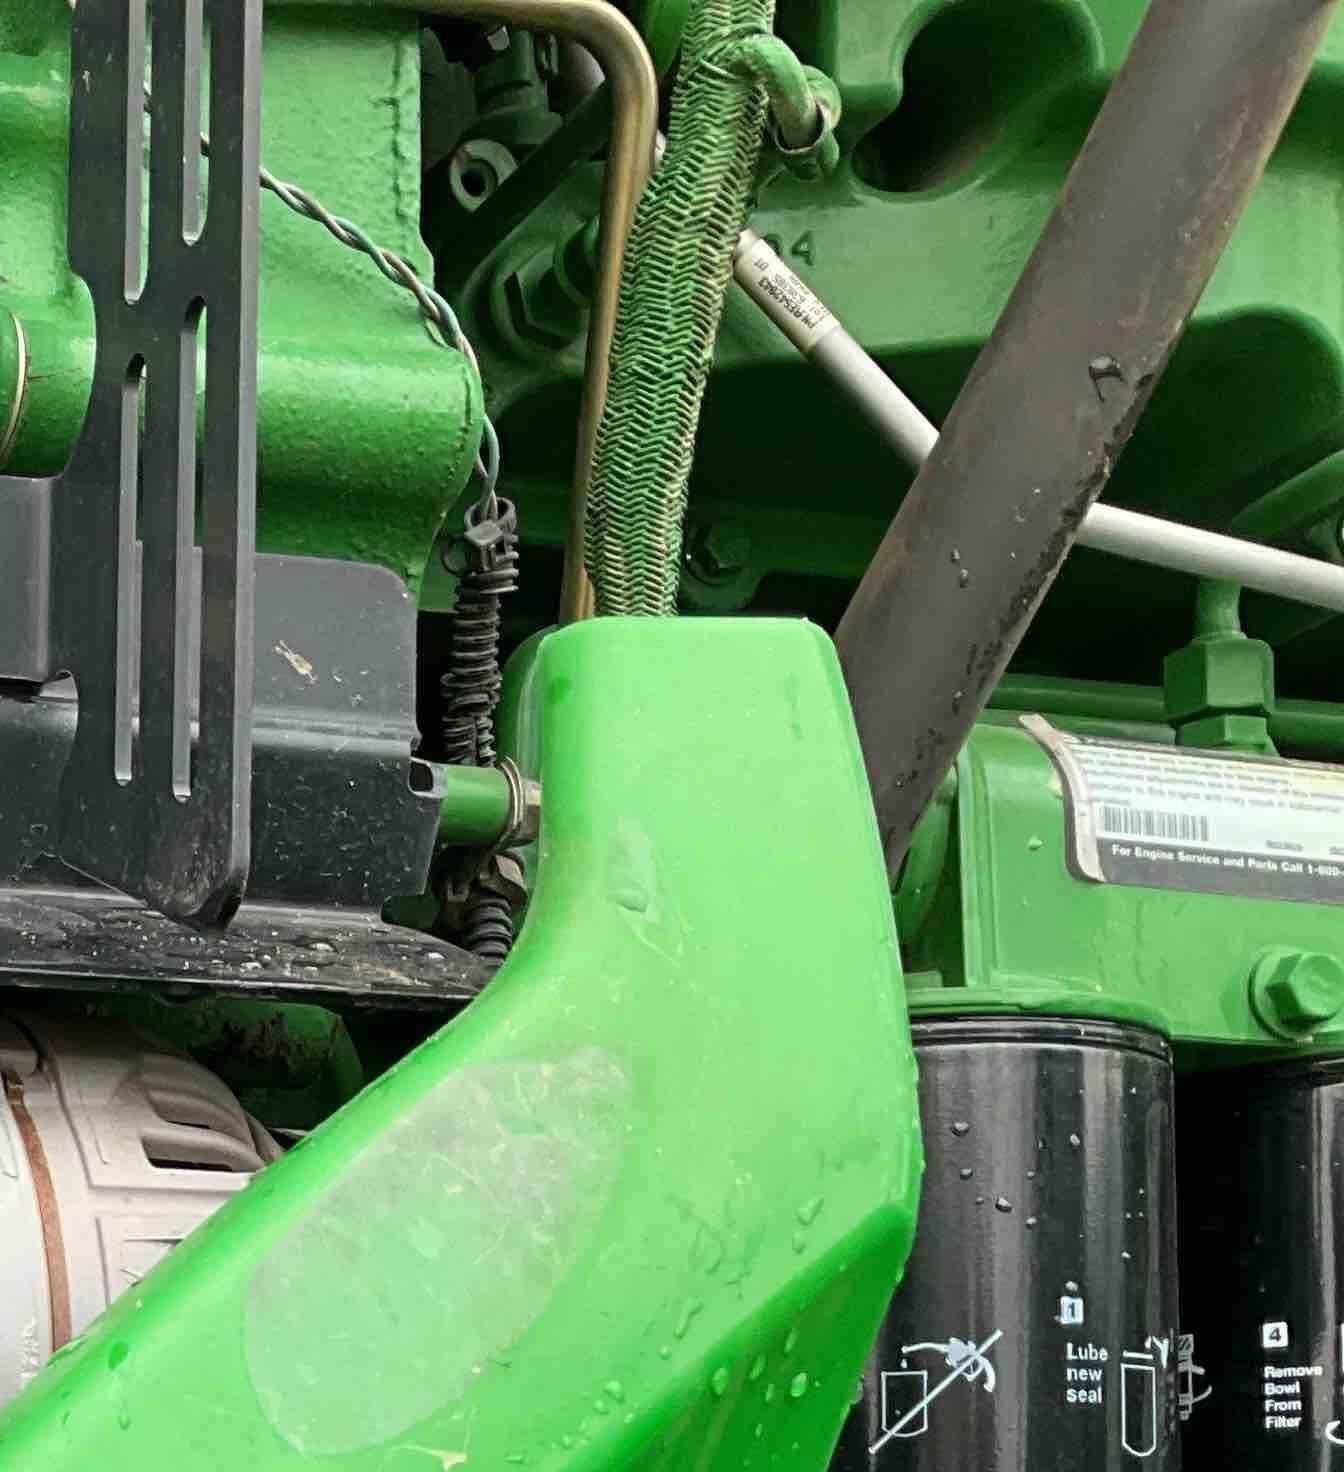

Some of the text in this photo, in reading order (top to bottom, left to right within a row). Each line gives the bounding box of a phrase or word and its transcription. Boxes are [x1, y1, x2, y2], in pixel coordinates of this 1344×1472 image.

[1112, 844, 1131, 856] For
[1281, 861, 1303, 873] Call
[1066, 1342, 1109, 1361] Lube
[1066, 1367, 1102, 1382] new
[1264, 1366, 1323, 1378] Remove
[1066, 1386, 1102, 1404] seal
[1264, 1381, 1300, 1395] Bowl
[1264, 1399, 1302, 1412] From
[1265, 1415, 1302, 1429] Filter
